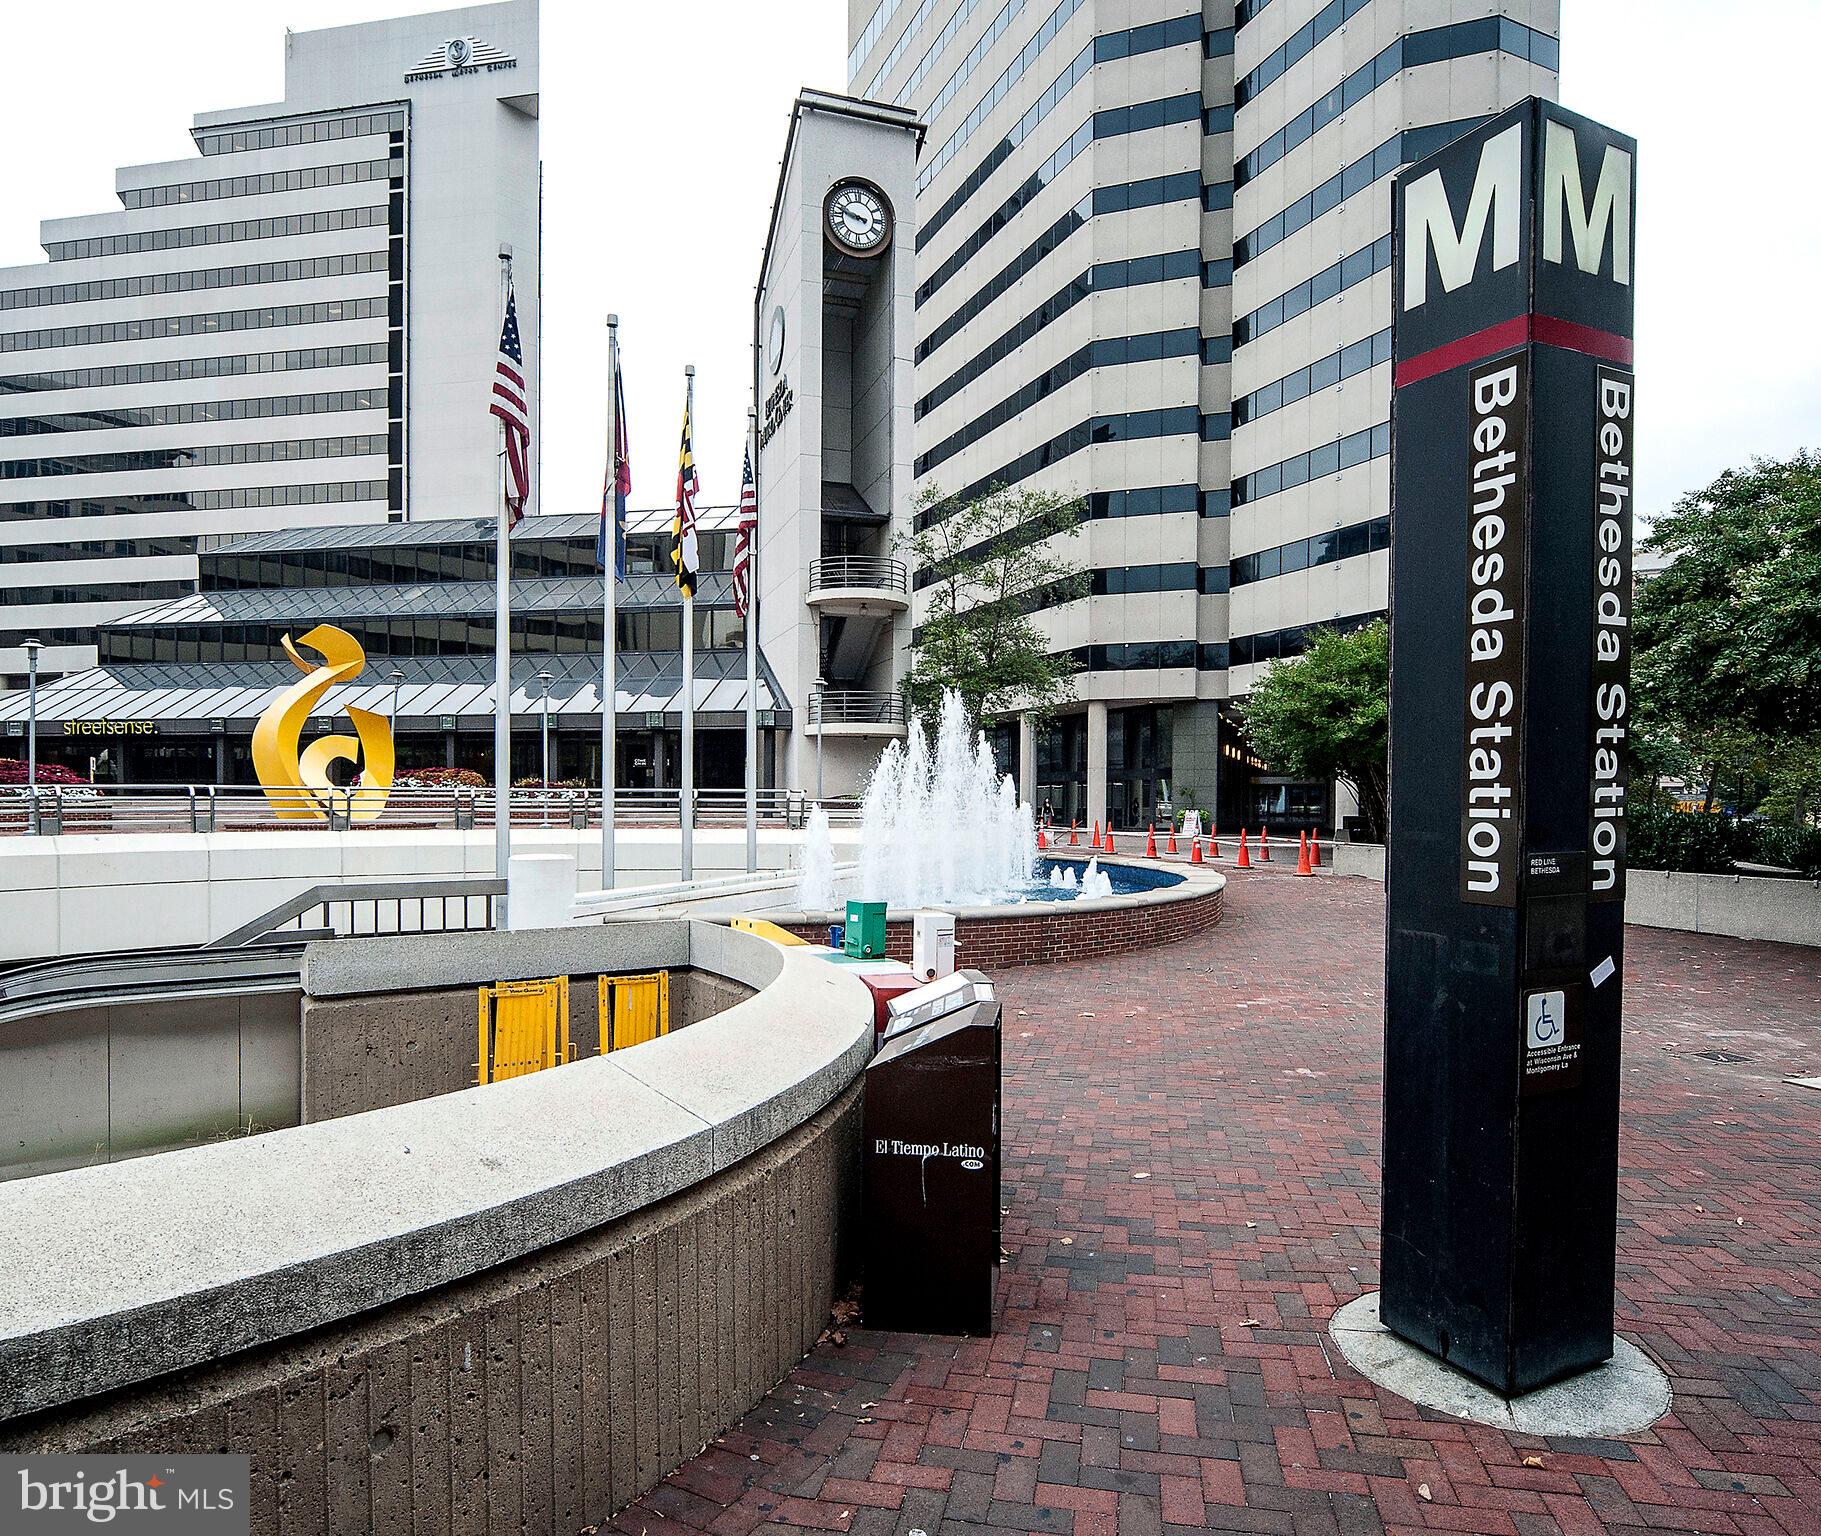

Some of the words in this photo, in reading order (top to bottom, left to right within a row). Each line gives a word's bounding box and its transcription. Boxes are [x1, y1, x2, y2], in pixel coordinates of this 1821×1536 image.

[1404, 121, 1522, 312] M
[1543, 118, 1632, 286] M
[1471, 365, 1517, 662] Bethesda
[1597, 378, 1630, 662] Bethesda
[1467, 681, 1513, 892] Station
[1592, 683, 1626, 890] Station
[1530, 858, 1543, 866] RED
[1530, 866, 1560, 875] BETHESDA
[1526, 1047, 1556, 1057] Accessible
[1557, 1044, 1581, 1053] Entrance
[1526, 1064, 1560, 1075] Montgomery
[1533, 1055, 1562, 1065] Wisconsin
[875, 1139, 888, 1154] El
[890, 1140, 940, 1158] Tiempo
[942, 1142, 985, 1158] Latino
